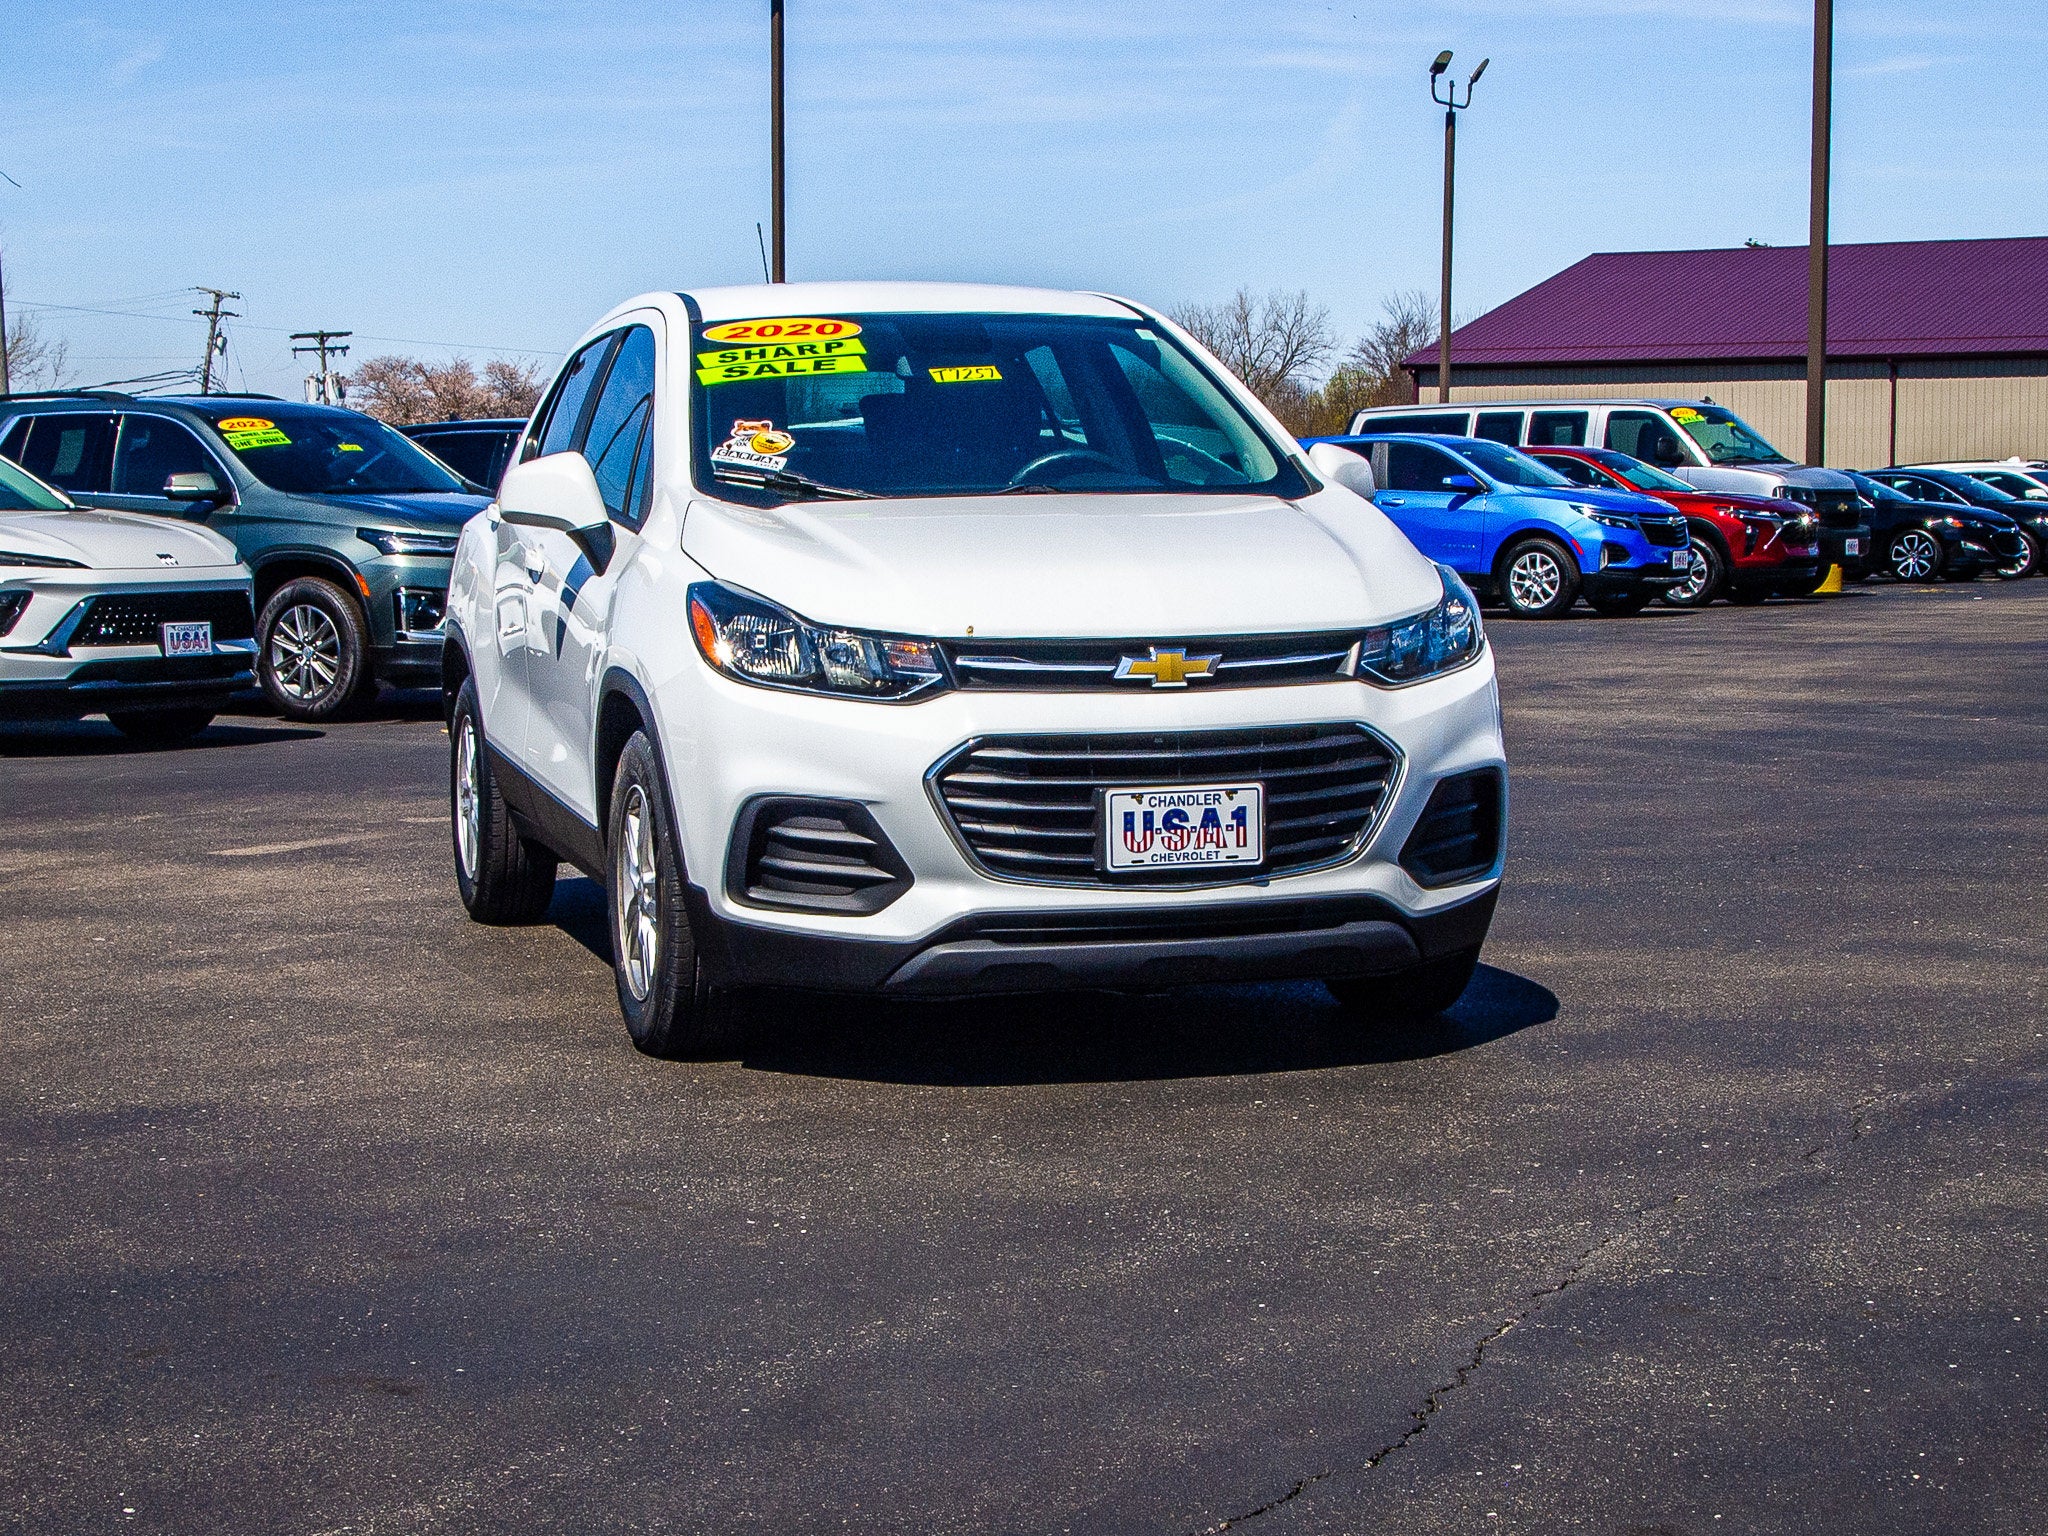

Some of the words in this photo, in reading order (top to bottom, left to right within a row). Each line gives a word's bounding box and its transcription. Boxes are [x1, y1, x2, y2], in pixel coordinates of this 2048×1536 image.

[724, 323, 843, 339] 2020
[718, 341, 844, 363] SHARP
[722, 359, 837, 378] SALE
[234, 440, 253, 448] ONE
[256, 437, 286, 445] OWNER
[1148, 793, 1222, 808] CHANDLER
[1151, 850, 1221, 863] CHEVROLET
